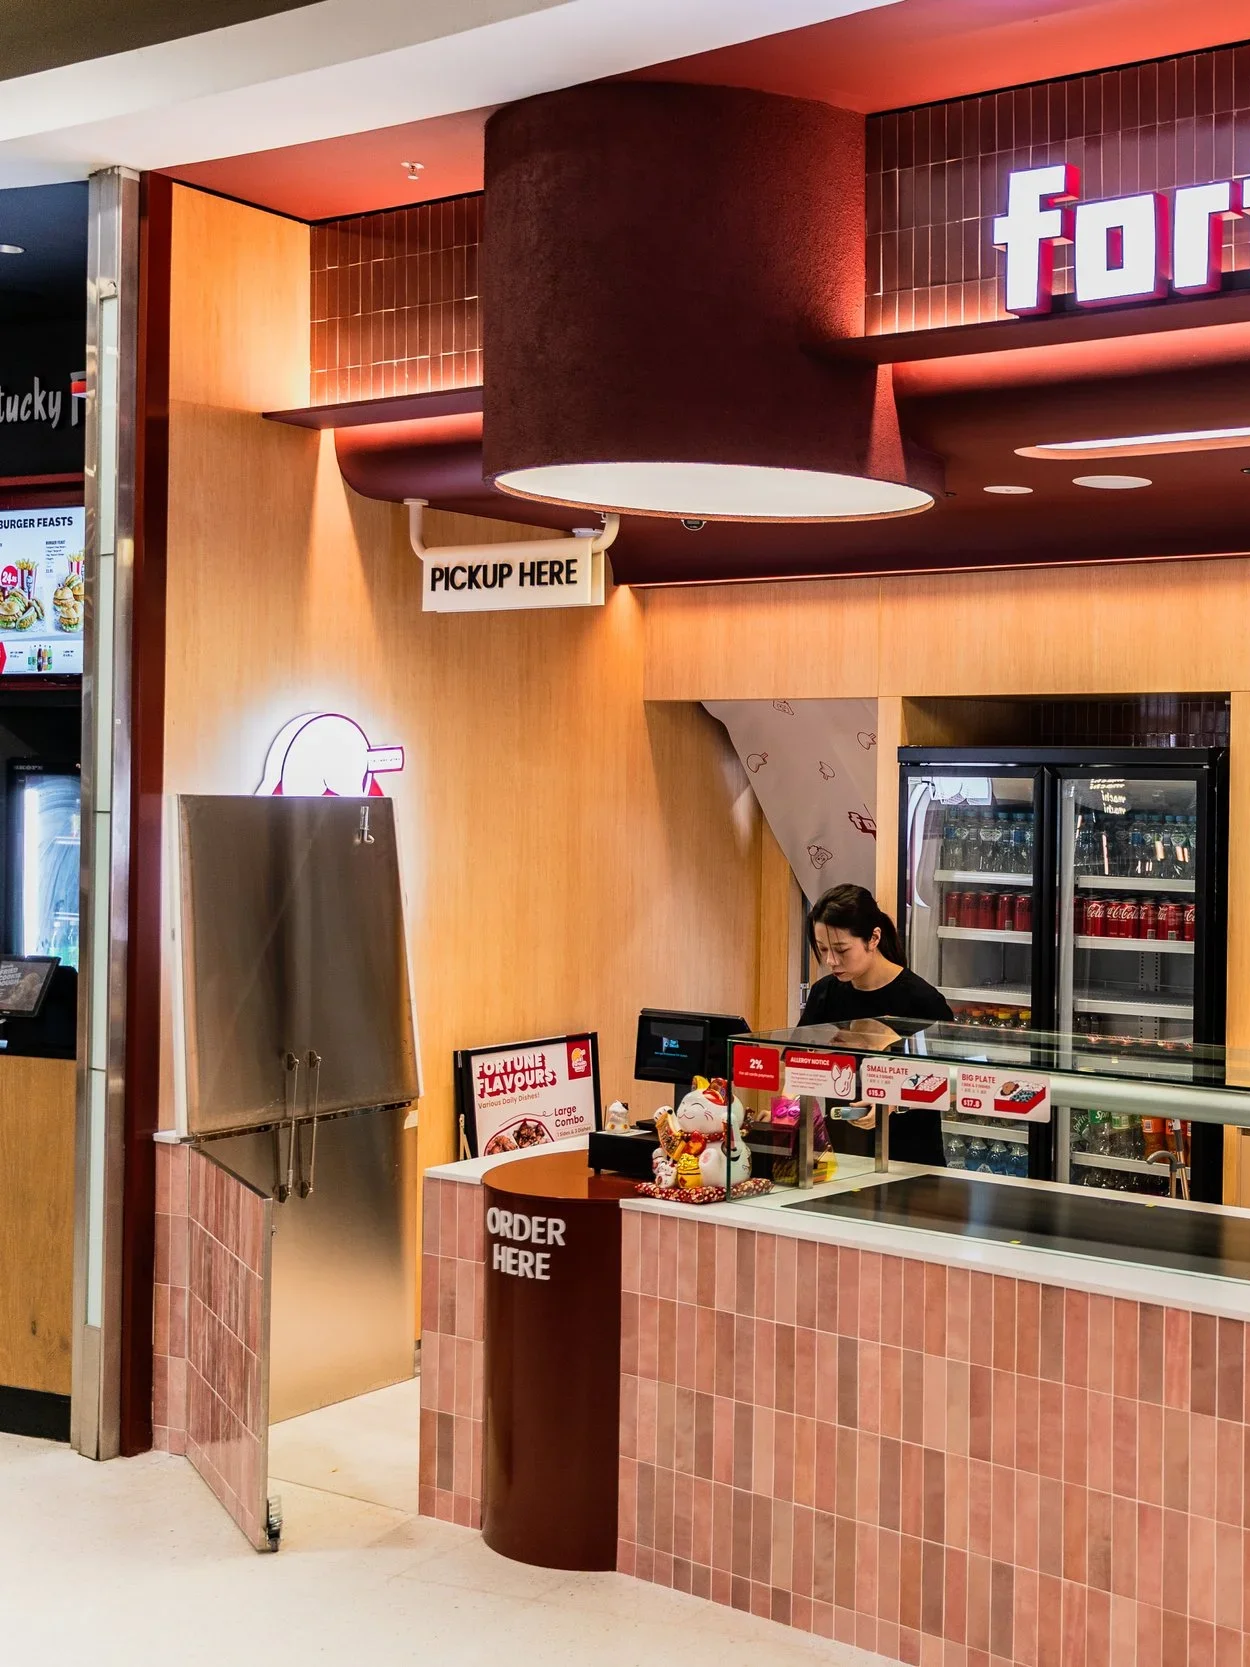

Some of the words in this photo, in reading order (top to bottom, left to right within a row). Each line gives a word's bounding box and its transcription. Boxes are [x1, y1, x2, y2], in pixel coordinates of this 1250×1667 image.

[37, 516, 73, 527] FEASTS
[431, 563, 513, 591] PICKUP
[519, 559, 578, 587] HERE
[477, 1052, 546, 1078] FORTUNE
[749, 1058, 763, 1070] 2%
[867, 1065, 888, 1074] SMALL
[889, 1066, 908, 1075] PLATE
[478, 1069, 557, 1098] FLAVOURS
[962, 1074, 974, 1082] BIG
[975, 1075, 996, 1084] PLATE
[478, 1100, 501, 1110] Various
[502, 1096, 517, 1105] Daily
[518, 1092, 540, 1101] Dishes!
[554, 1106, 576, 1116] Large
[555, 1115, 584, 1127] Combo
[487, 1206, 566, 1246] ORDER
[493, 1243, 550, 1280] HERE
